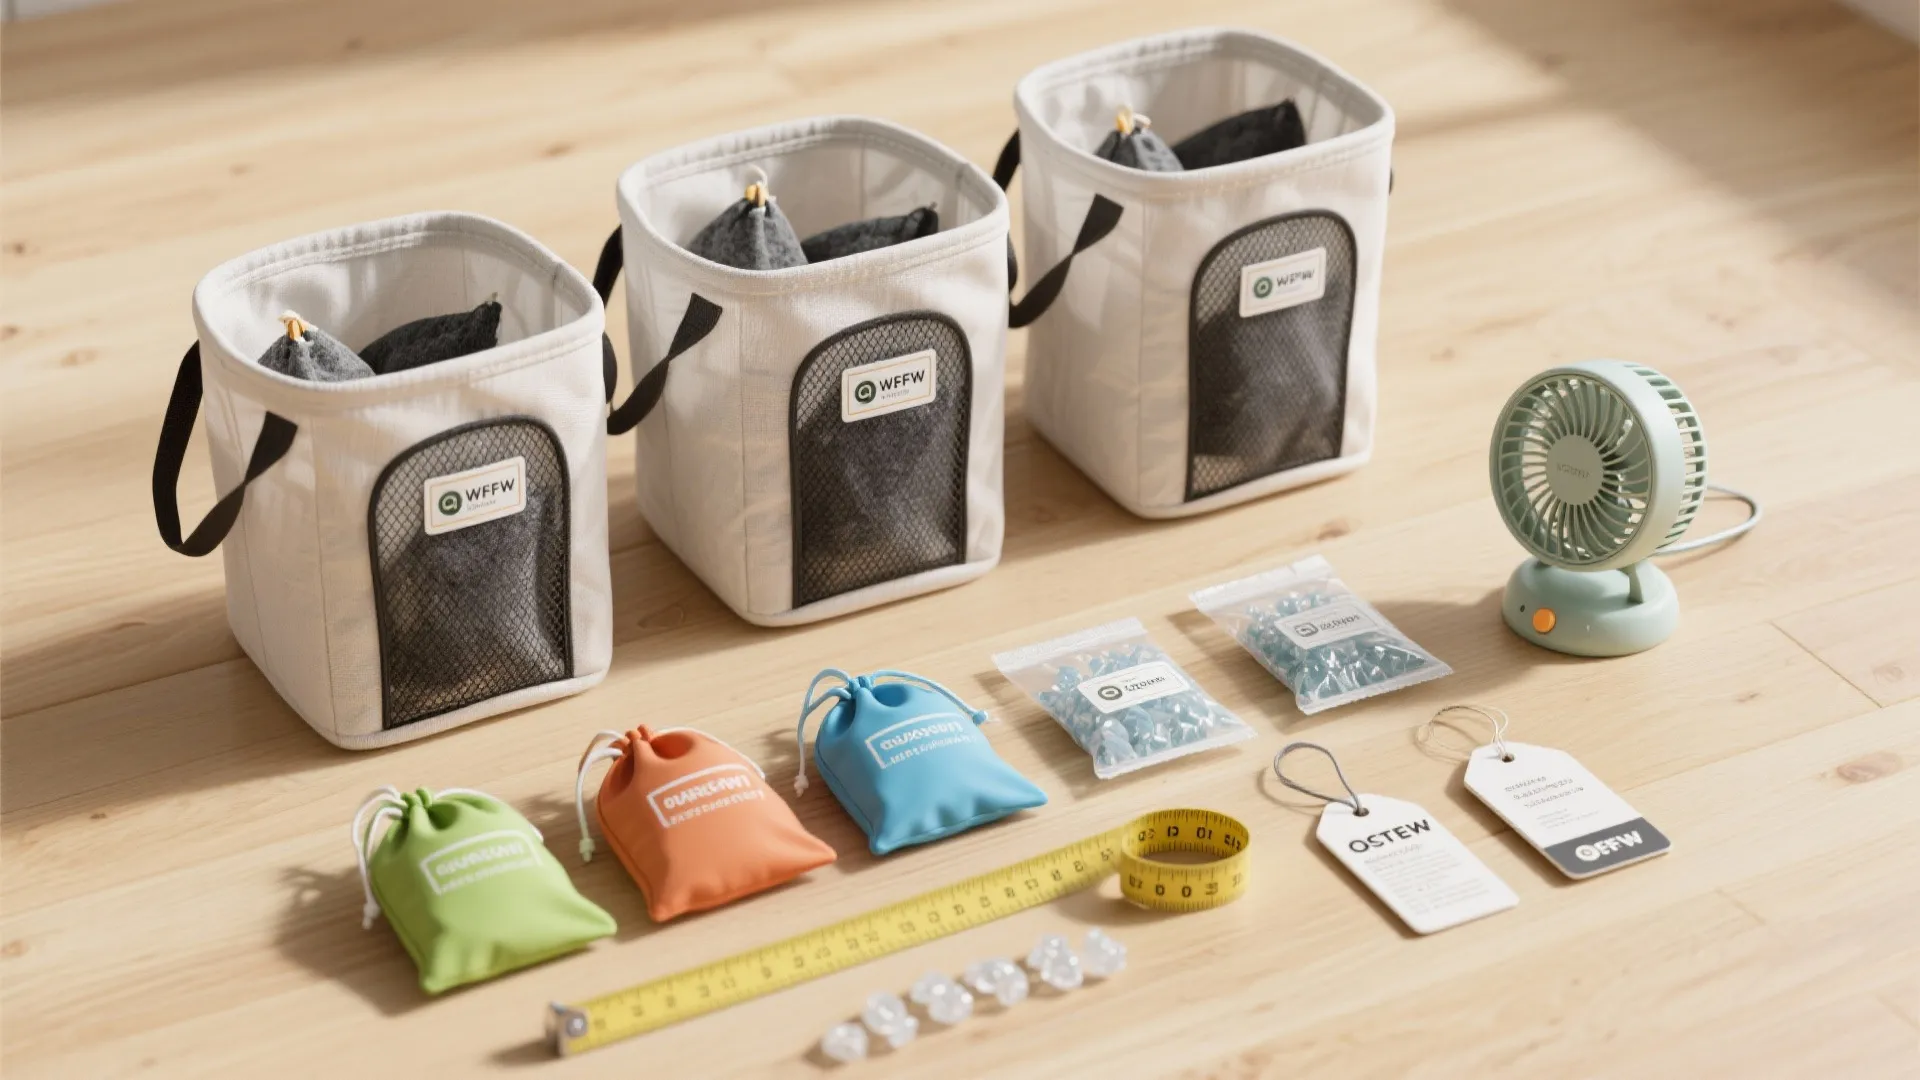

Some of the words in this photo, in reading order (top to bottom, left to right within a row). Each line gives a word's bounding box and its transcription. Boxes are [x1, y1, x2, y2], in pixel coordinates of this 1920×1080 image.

[879, 370, 925, 391] WFFW
[466, 478, 515, 501] WFFW
[1349, 819, 1431, 853] OSTEW
